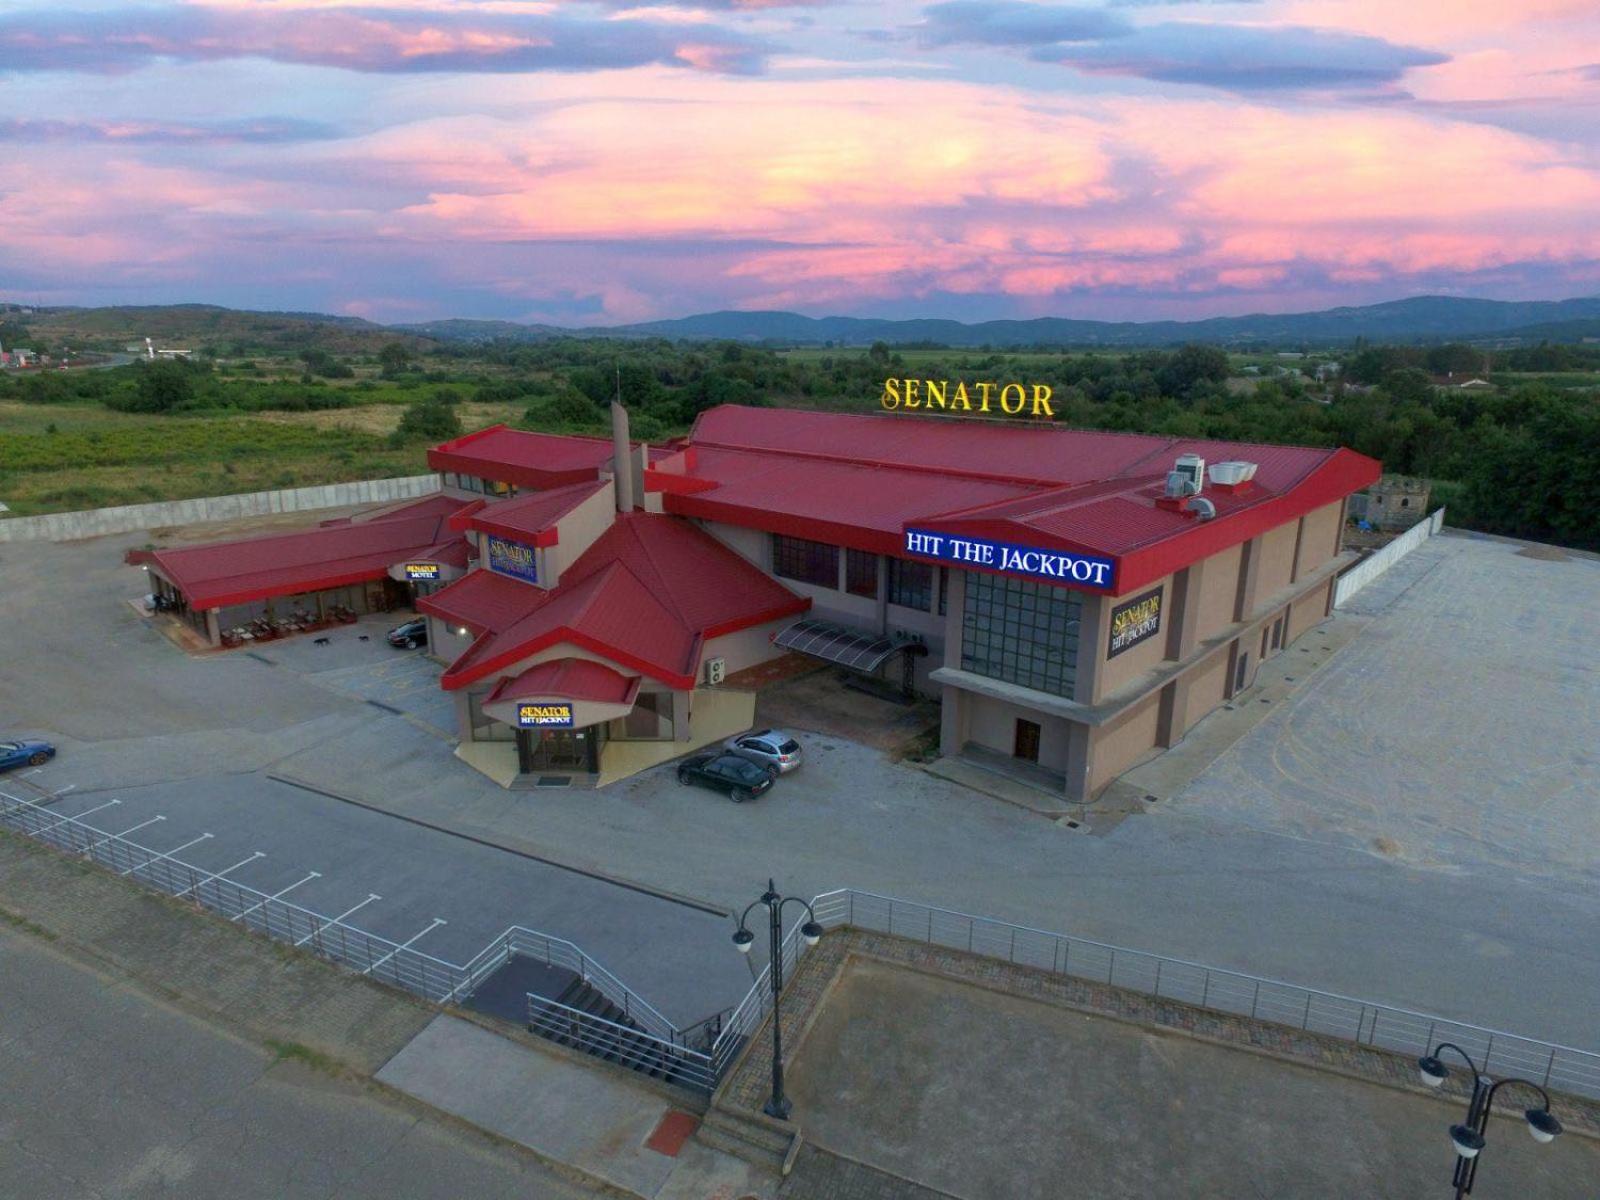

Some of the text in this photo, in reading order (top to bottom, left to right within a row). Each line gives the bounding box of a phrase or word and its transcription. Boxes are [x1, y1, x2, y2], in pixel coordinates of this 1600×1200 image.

[881, 377, 1055, 416] SENATOR
[906, 532, 1110, 585] HIT THE JACKPOT
[1113, 595, 1159, 636] SENATOR
[1112, 633, 1124, 651] HIT
[520, 706, 570, 716] SENATOR
